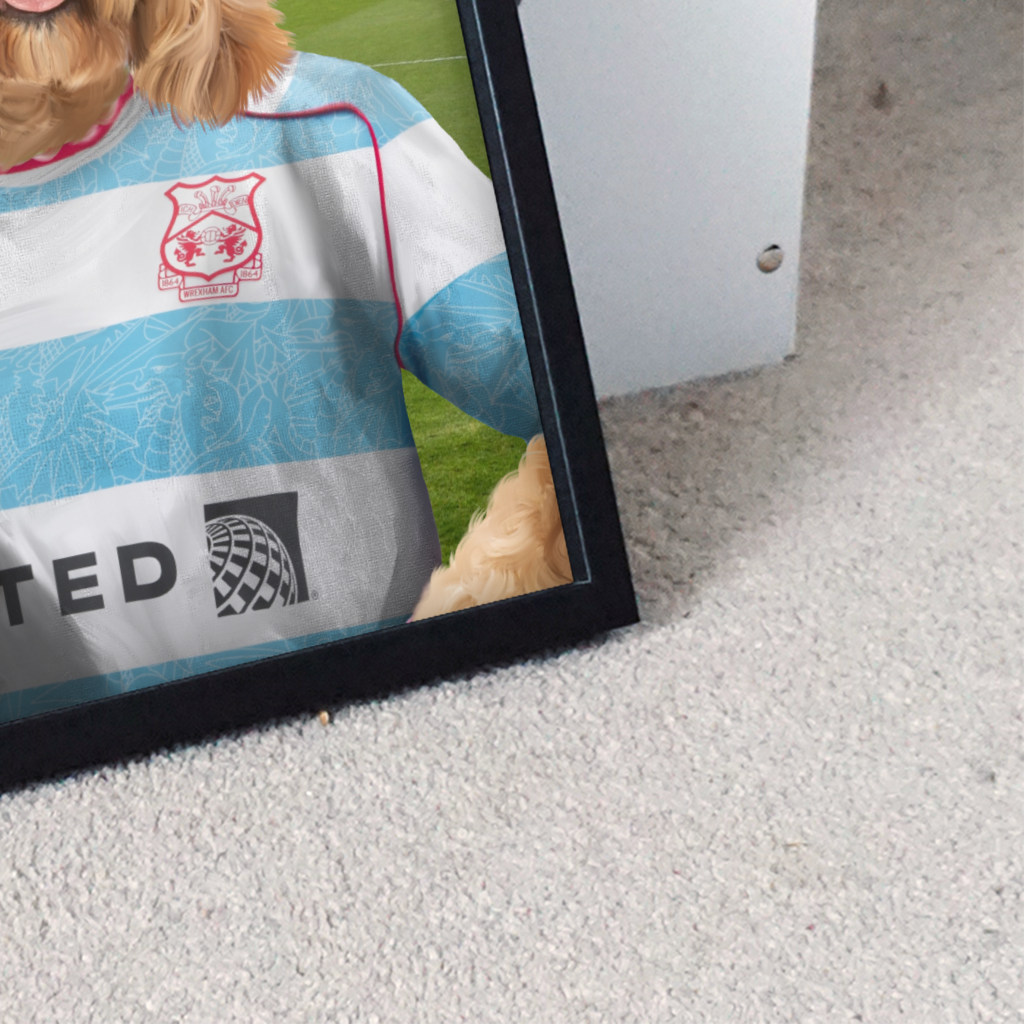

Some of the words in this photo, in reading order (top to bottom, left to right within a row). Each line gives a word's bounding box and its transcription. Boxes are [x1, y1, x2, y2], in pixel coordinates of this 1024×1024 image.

[240, 269, 258, 277] 1864
[161, 278, 179, 287] 1864
[183, 286, 219, 298] WREXHAM
[220, 285, 234, 295] AFC
